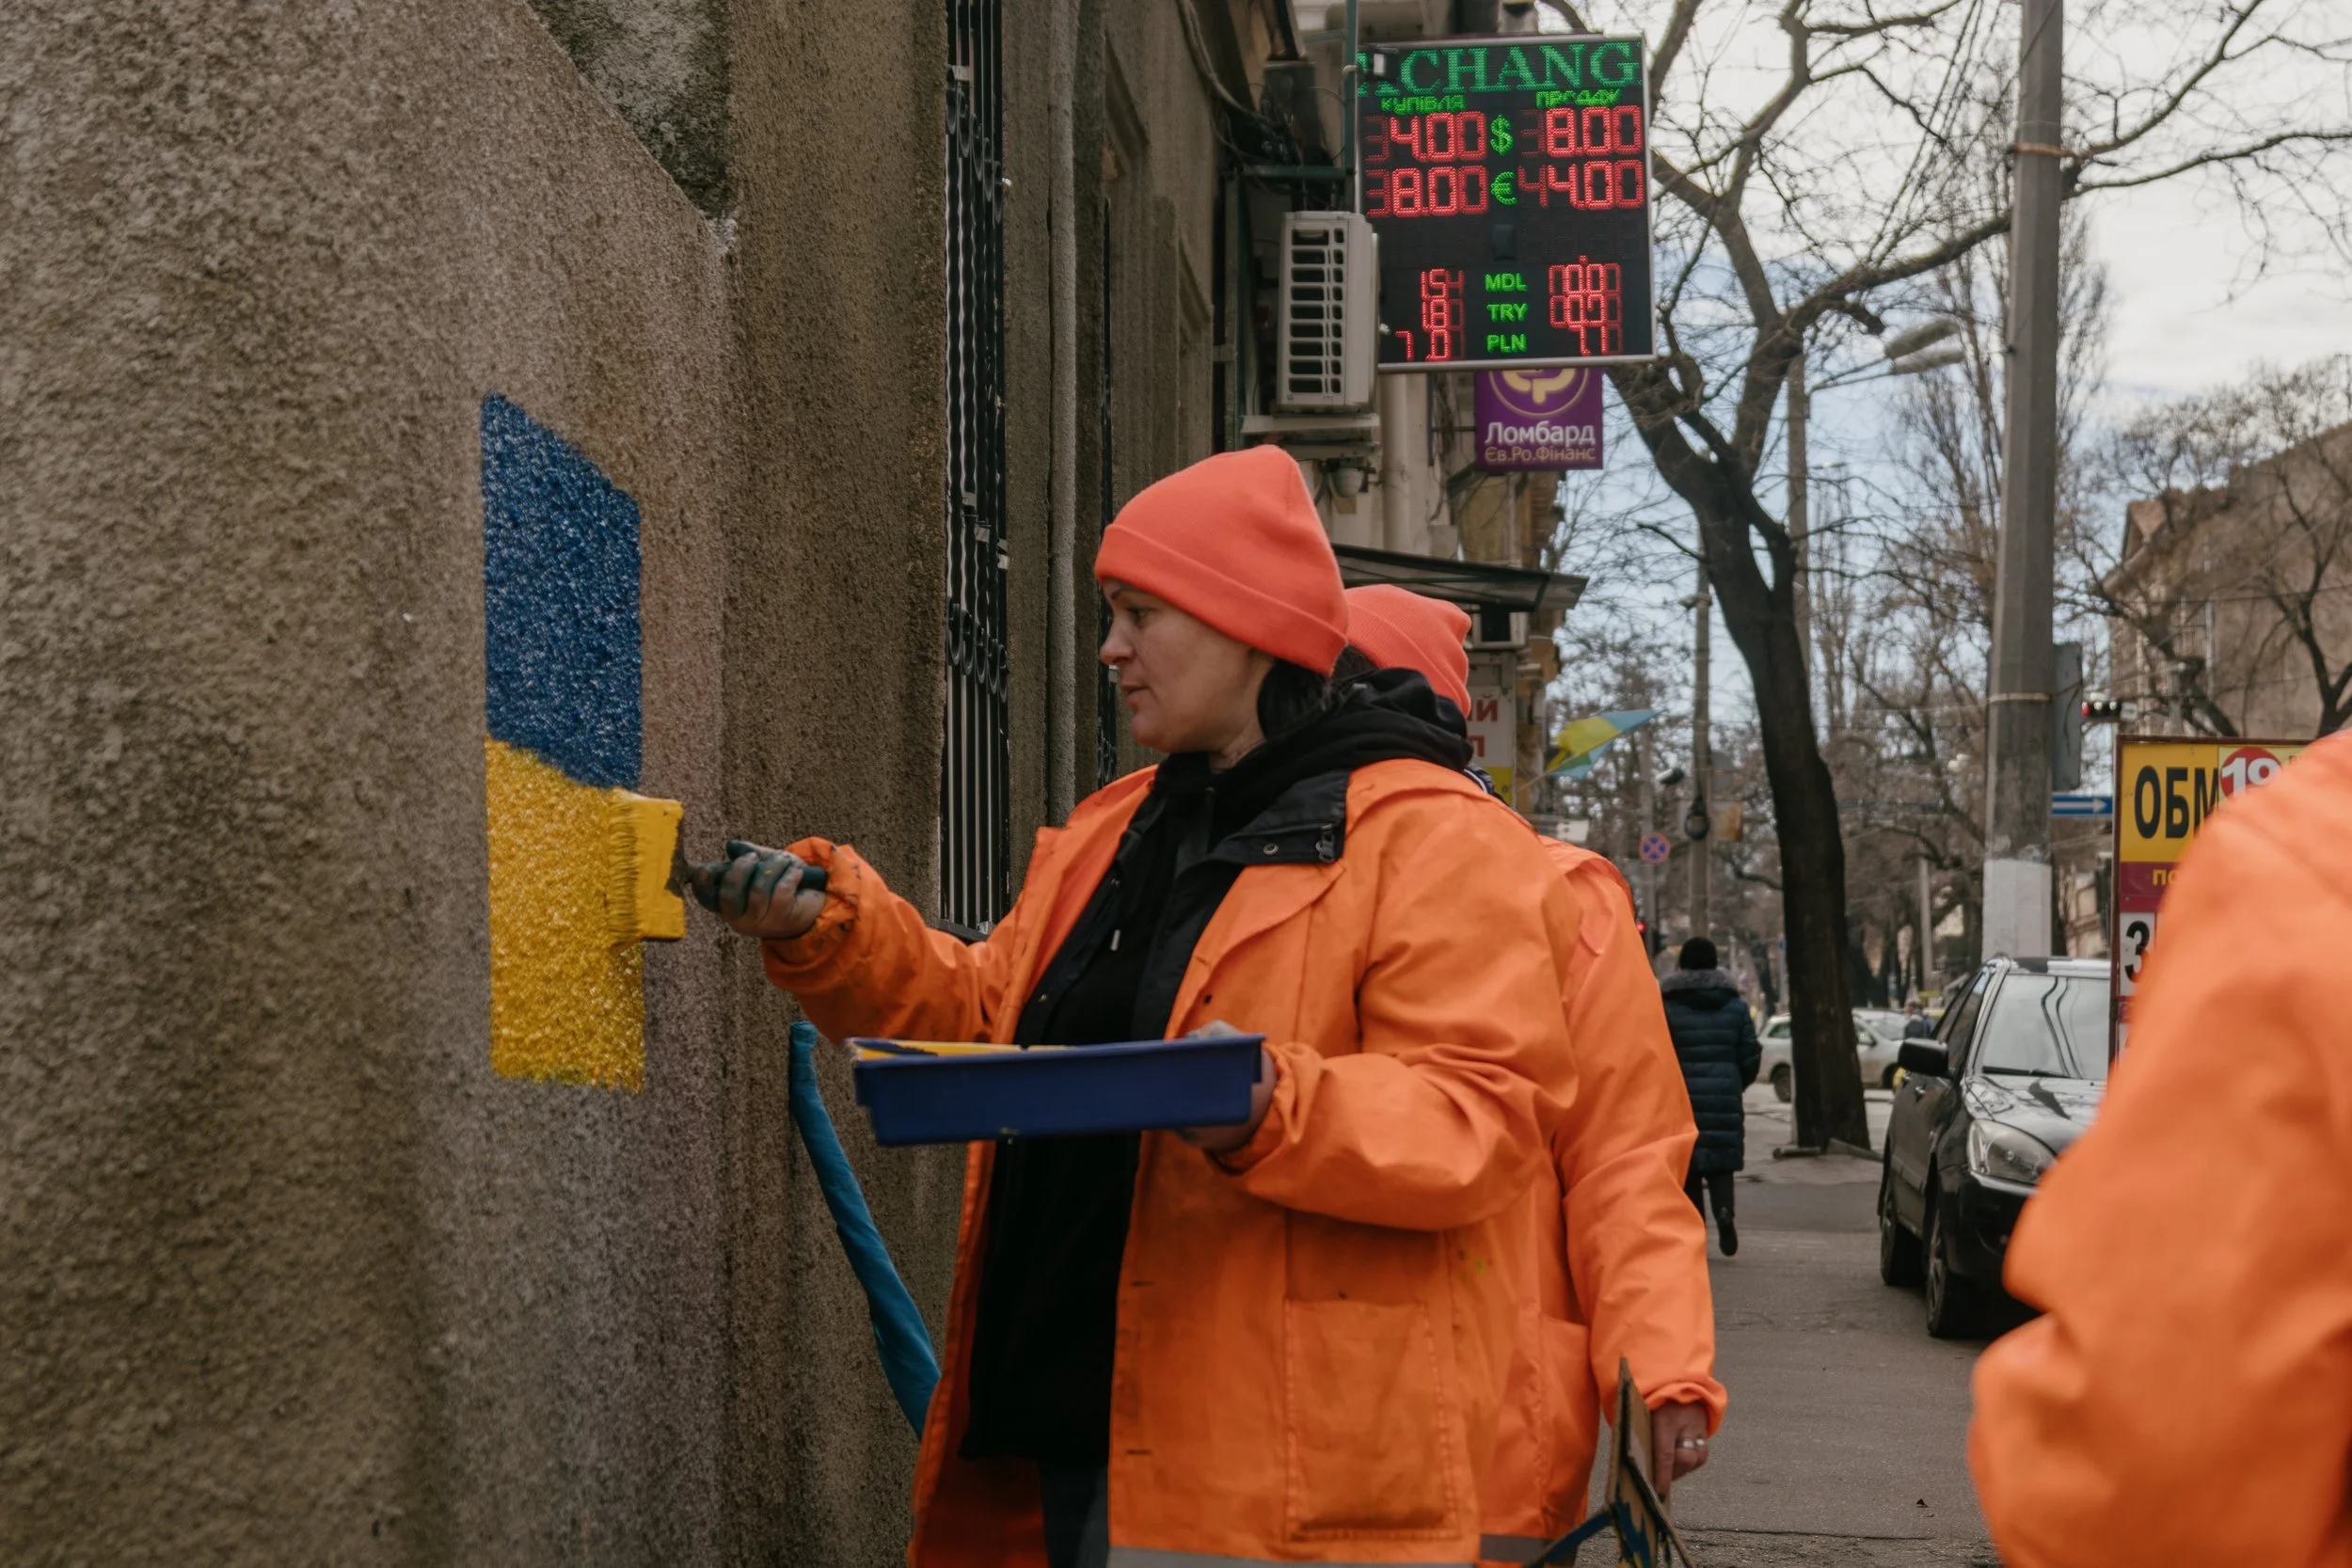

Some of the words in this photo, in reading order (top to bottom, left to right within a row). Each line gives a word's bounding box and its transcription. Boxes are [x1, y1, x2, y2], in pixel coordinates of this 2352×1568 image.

[1490, 115, 1514, 155] $
[1490, 171, 1518, 205] €
[1484, 273, 1528, 293] MDL
[1486, 302, 1529, 323] TRY
[1486, 333, 1528, 354] PLN
[1484, 420, 1597, 448] Ломбард
